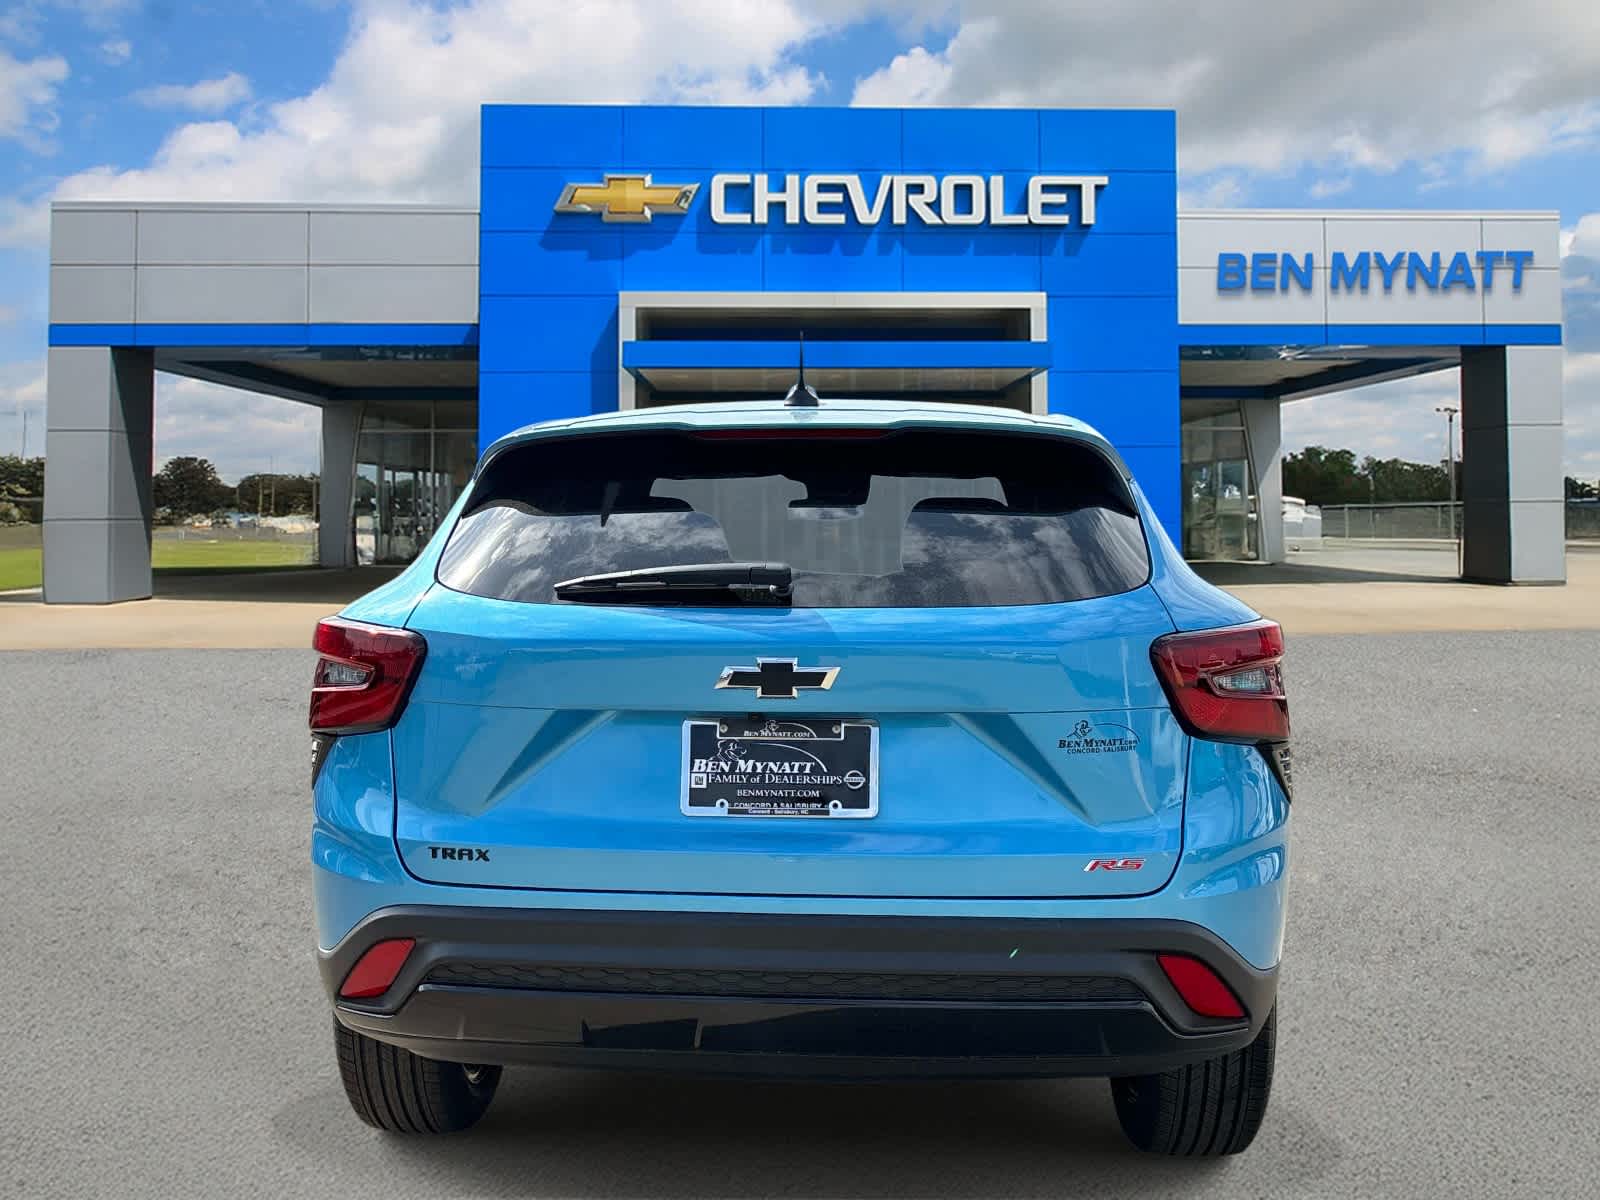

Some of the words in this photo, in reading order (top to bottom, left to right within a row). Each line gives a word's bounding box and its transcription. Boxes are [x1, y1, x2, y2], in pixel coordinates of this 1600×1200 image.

[710, 173, 1110, 225] CHEVROLET
[1216, 252, 1314, 291] BEN
[1329, 250, 1535, 291] MYNATT
[691, 758, 732, 773] BEN
[734, 759, 816, 774] MYNATT
[708, 773, 749, 784] FAMILY
[750, 774, 762, 784] of
[764, 773, 843, 785] DEALERSHIPS
[736, 788, 821, 798] BENMYNATT.COM
[428, 846, 491, 862] TRAX
[1083, 858, 1146, 872] RS
